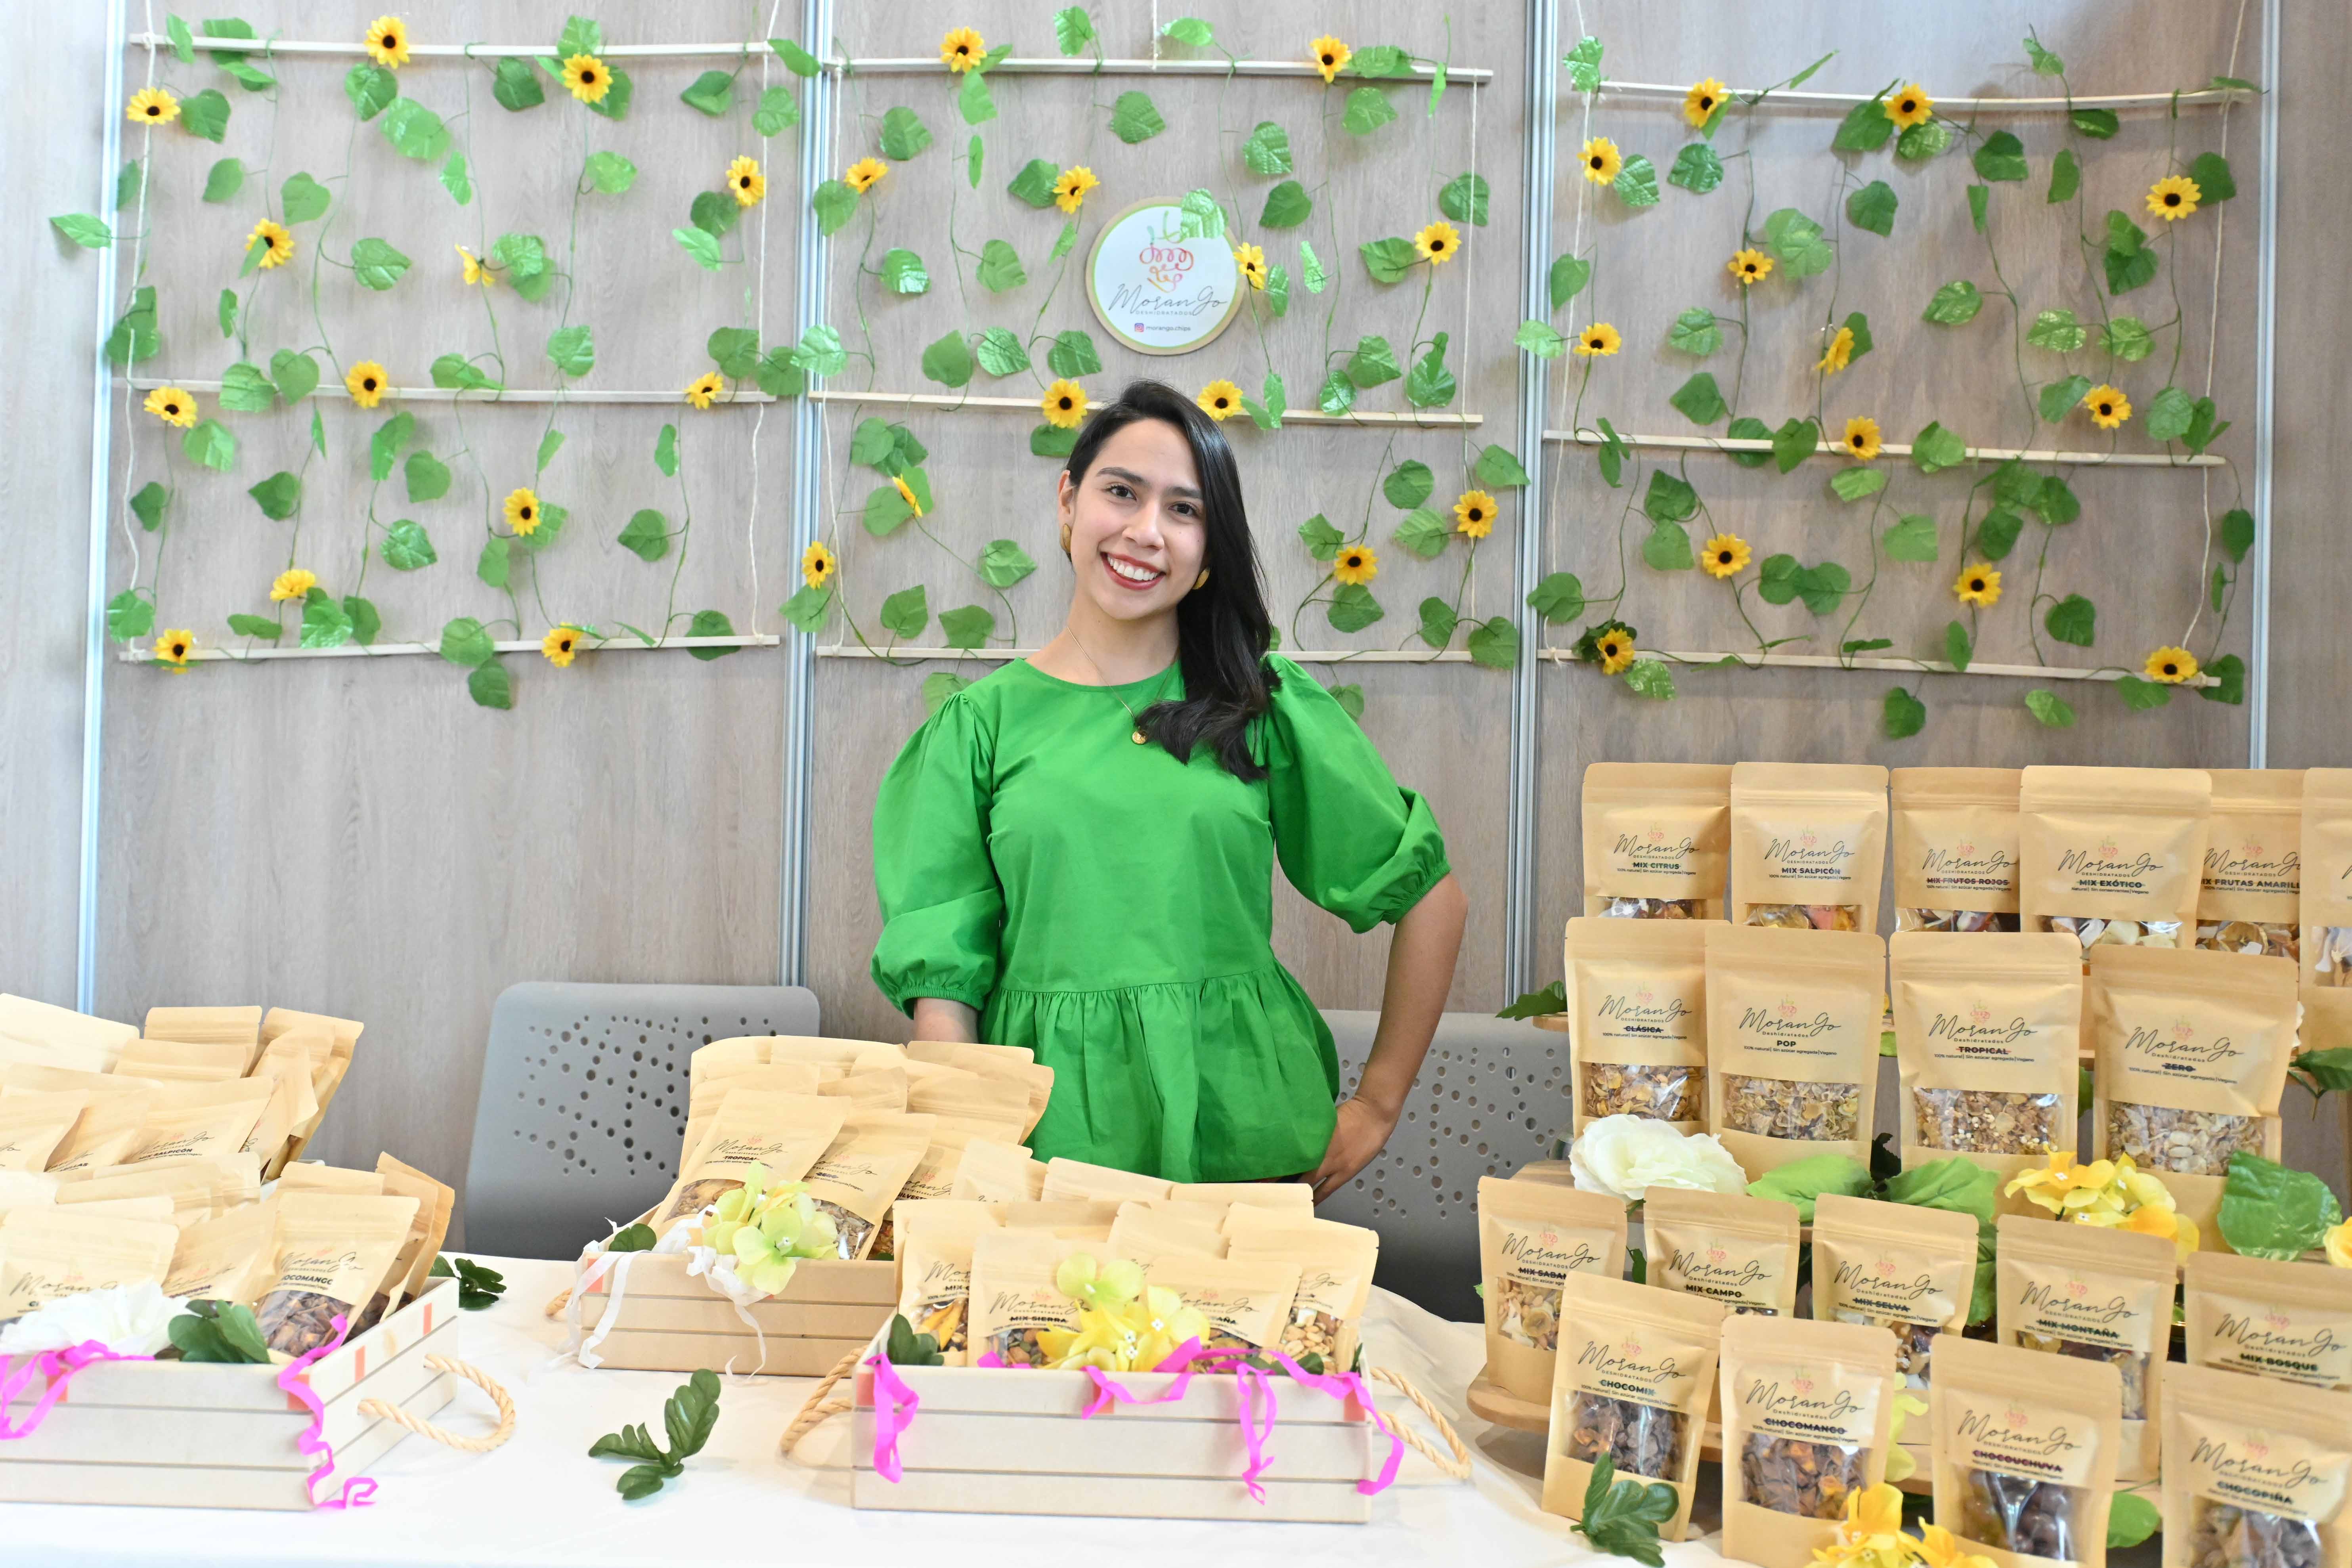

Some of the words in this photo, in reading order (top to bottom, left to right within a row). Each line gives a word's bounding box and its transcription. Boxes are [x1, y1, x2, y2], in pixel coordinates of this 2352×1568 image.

[1108, 284, 1227, 316] MoranGo
[1614, 834, 1700, 859] MoranGo
[1765, 839, 1855, 863] MoranGo
[1922, 849, 2016, 874] MoranGo
[2058, 850, 2163, 877] MoranGo
[2100, 880, 2142, 888] EXÓTICO
[1599, 995, 1692, 1022] MoranGo
[1739, 1008, 1841, 1036] MoranGo
[1929, 1014, 2037, 1043] MoranGo
[2125, 1027, 2244, 1062] MoranGo
[2165, 1063, 2194, 1072] ZERO
[711, 1140, 788, 1155] MoranGo
[815, 1154, 878, 1175] oranGo
[1502, 1233, 1601, 1269] MoranGo
[1522, 1260, 1568, 1269] DESHIDRATADOS
[1669, 1249, 1772, 1286] MoranGo
[1686, 1284, 1703, 1293] MIX
[1706, 1287, 1742, 1298] CAMPO
[1689, 1276, 1738, 1287] Deshidratados
[1834, 1261, 1943, 1300] MoranGo
[1855, 1298, 1872, 1306] MIX
[1876, 1301, 1910, 1312] SELVA
[2021, 1281, 2139, 1323] MoranGo
[2039, 1319, 2058, 1328] MIX
[2061, 1323, 2119, 1339] MONTAÑA
[2215, 1314, 2347, 1357] MoranGo
[1578, 1341, 1687, 1383] MoranGo
[2240, 1353, 2262, 1363] MIX
[2266, 1358, 2318, 1371] BOSQUE
[1601, 1379, 1655, 1396] CHOCOMIX
[1602, 1369, 1652, 1383] DESHIDRATADOS
[1746, 1379, 1864, 1419] MoranGo
[1765, 1418, 1845, 1434] CHOCOMANGO
[1958, 1410, 2082, 1455] MoranGo
[1973, 1450, 2062, 1471] CHOCOUCHUVA
[2190, 1437, 2327, 1489] MoranGo
[2218, 1481, 2293, 1505] CHOCOPIÑA
